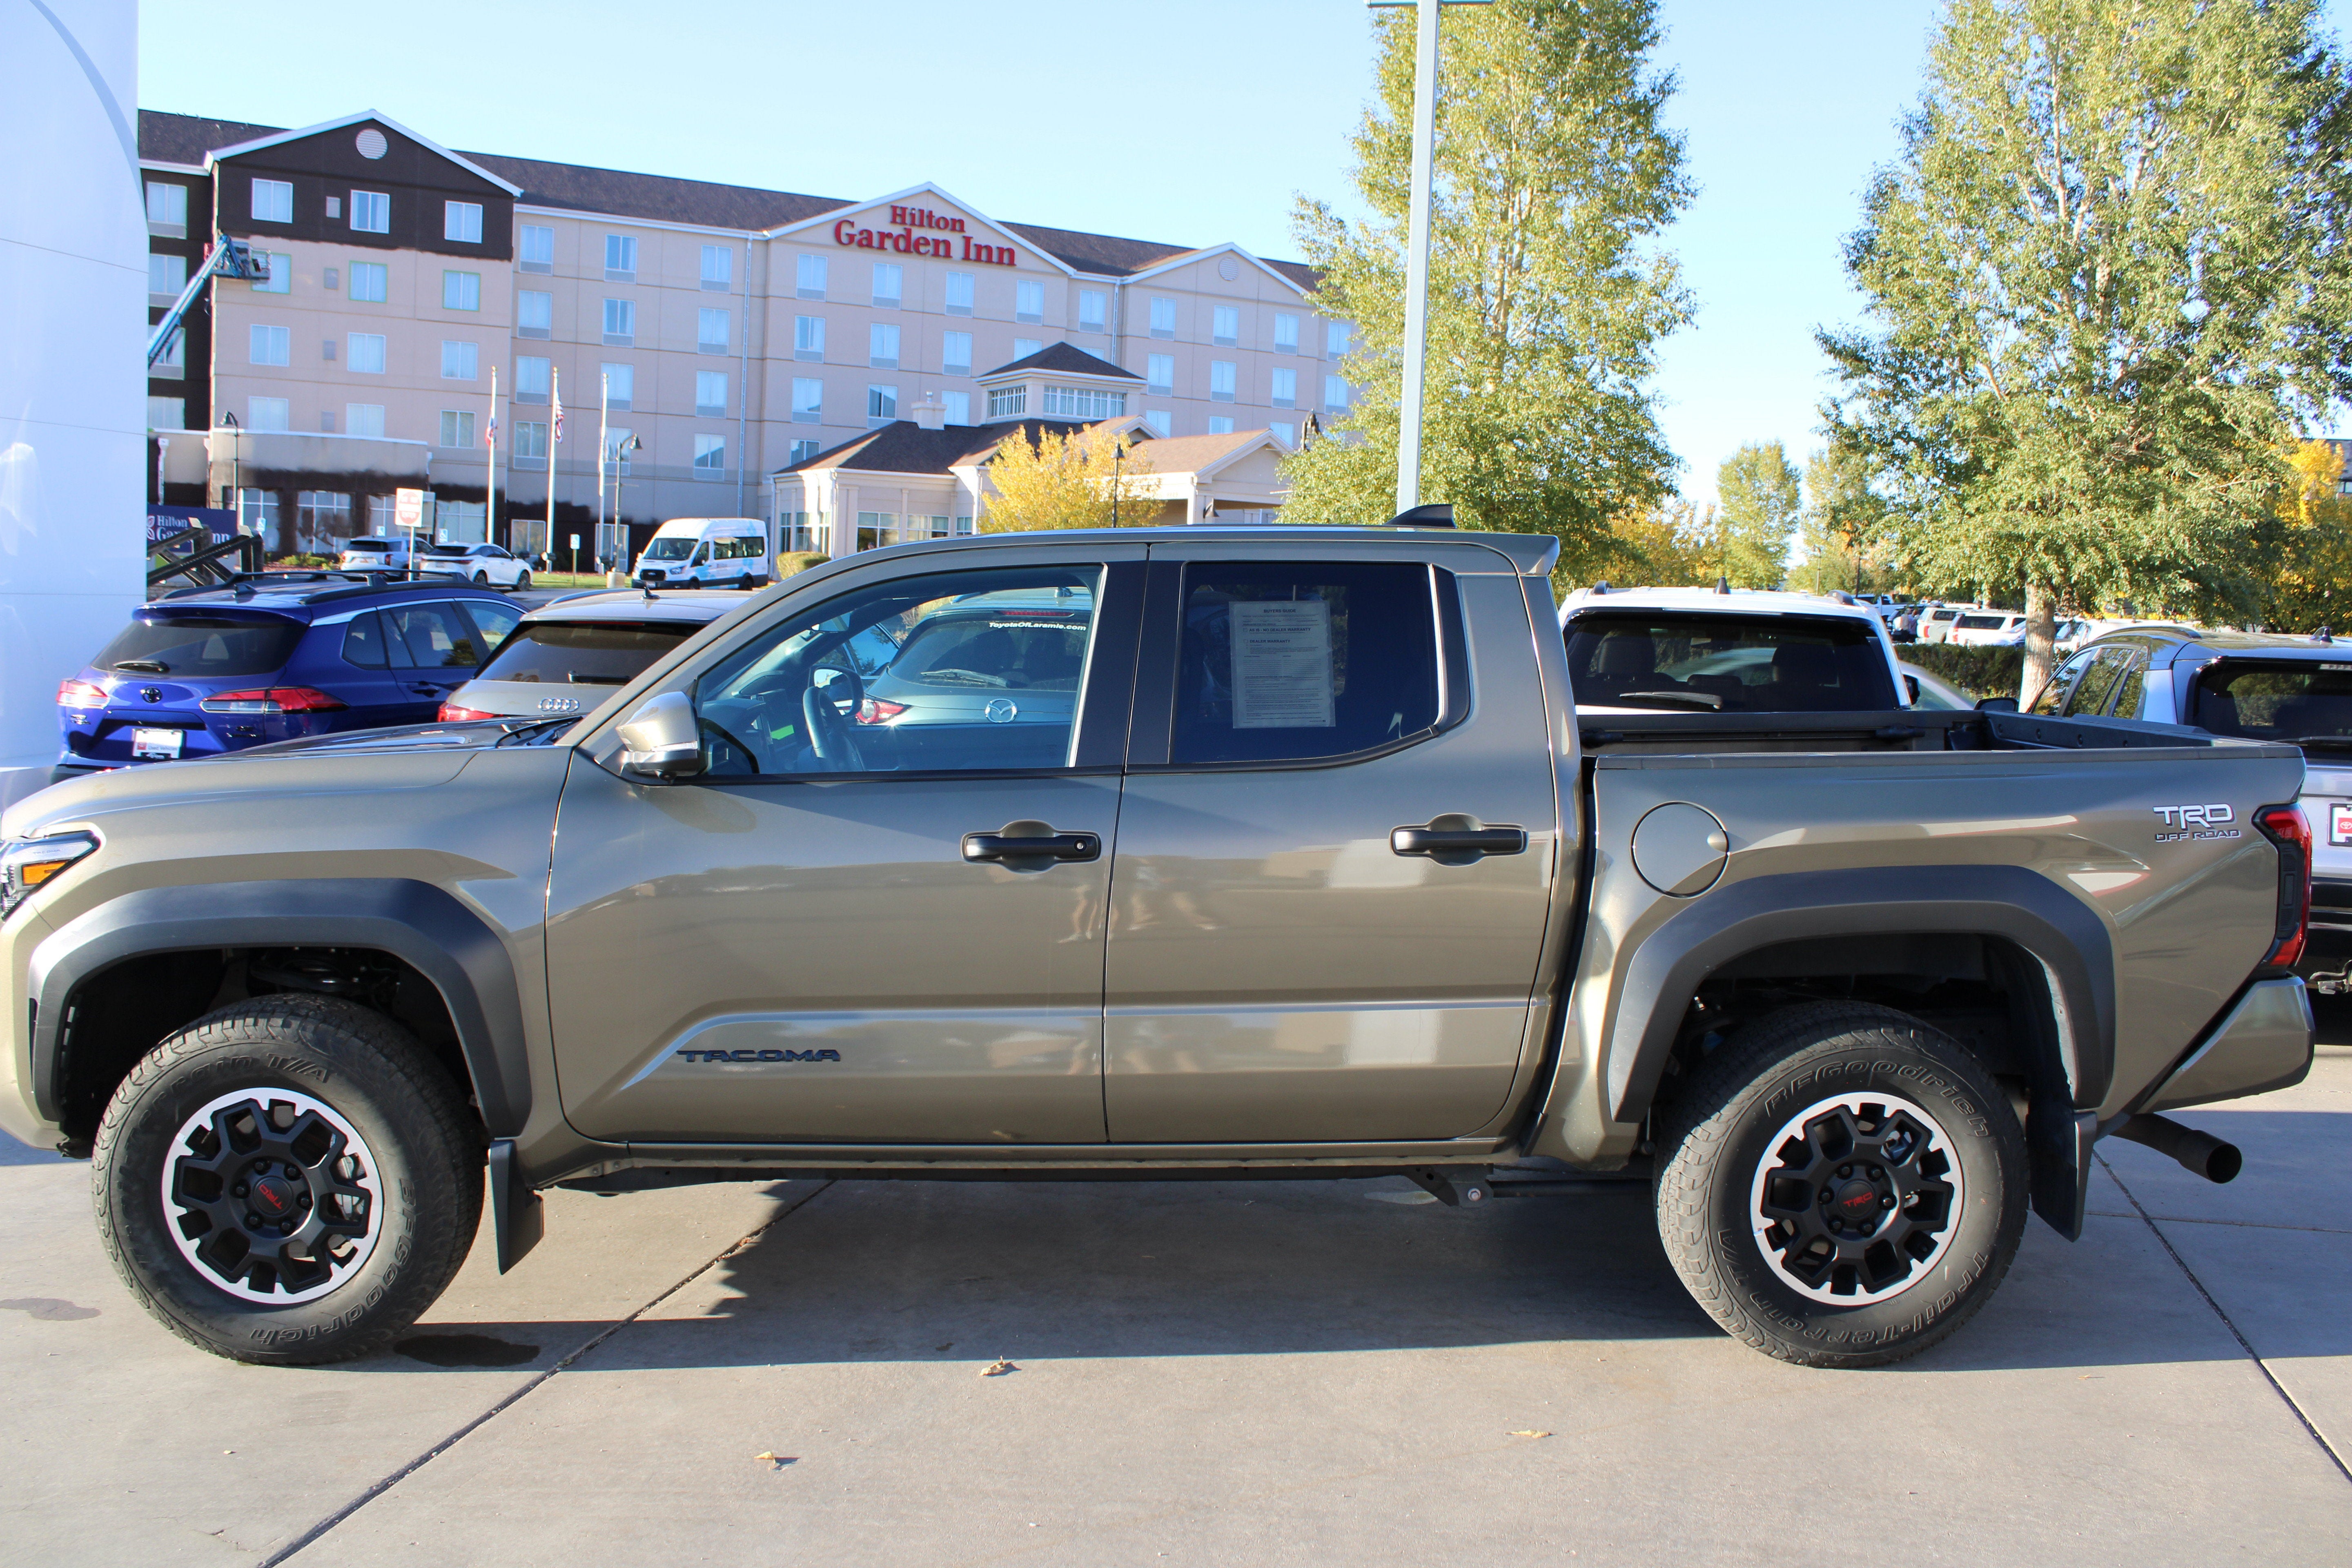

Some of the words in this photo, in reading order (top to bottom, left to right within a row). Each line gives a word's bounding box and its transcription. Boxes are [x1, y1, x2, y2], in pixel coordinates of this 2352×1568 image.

[890, 205, 966, 232] Hilton
[835, 219, 953, 258] Garden
[962, 236, 1016, 266] Inn
[156, 514, 188, 527] Hilton
[212, 532, 231, 544] nn
[989, 621, 1087, 631] ToyotaOfLaramie.com
[2153, 803, 2236, 831] TRD
[2154, 832, 2189, 842] OFF
[2192, 829, 2241, 841] ROAD
[676, 1049, 841, 1062] TACOMA
[1765, 1060, 1991, 1138] BFGoodrich
[258, 1184, 283, 1210] TRD
[1843, 1192, 1873, 1207] TRD
[250, 1178, 416, 1345] BFGoodrich
